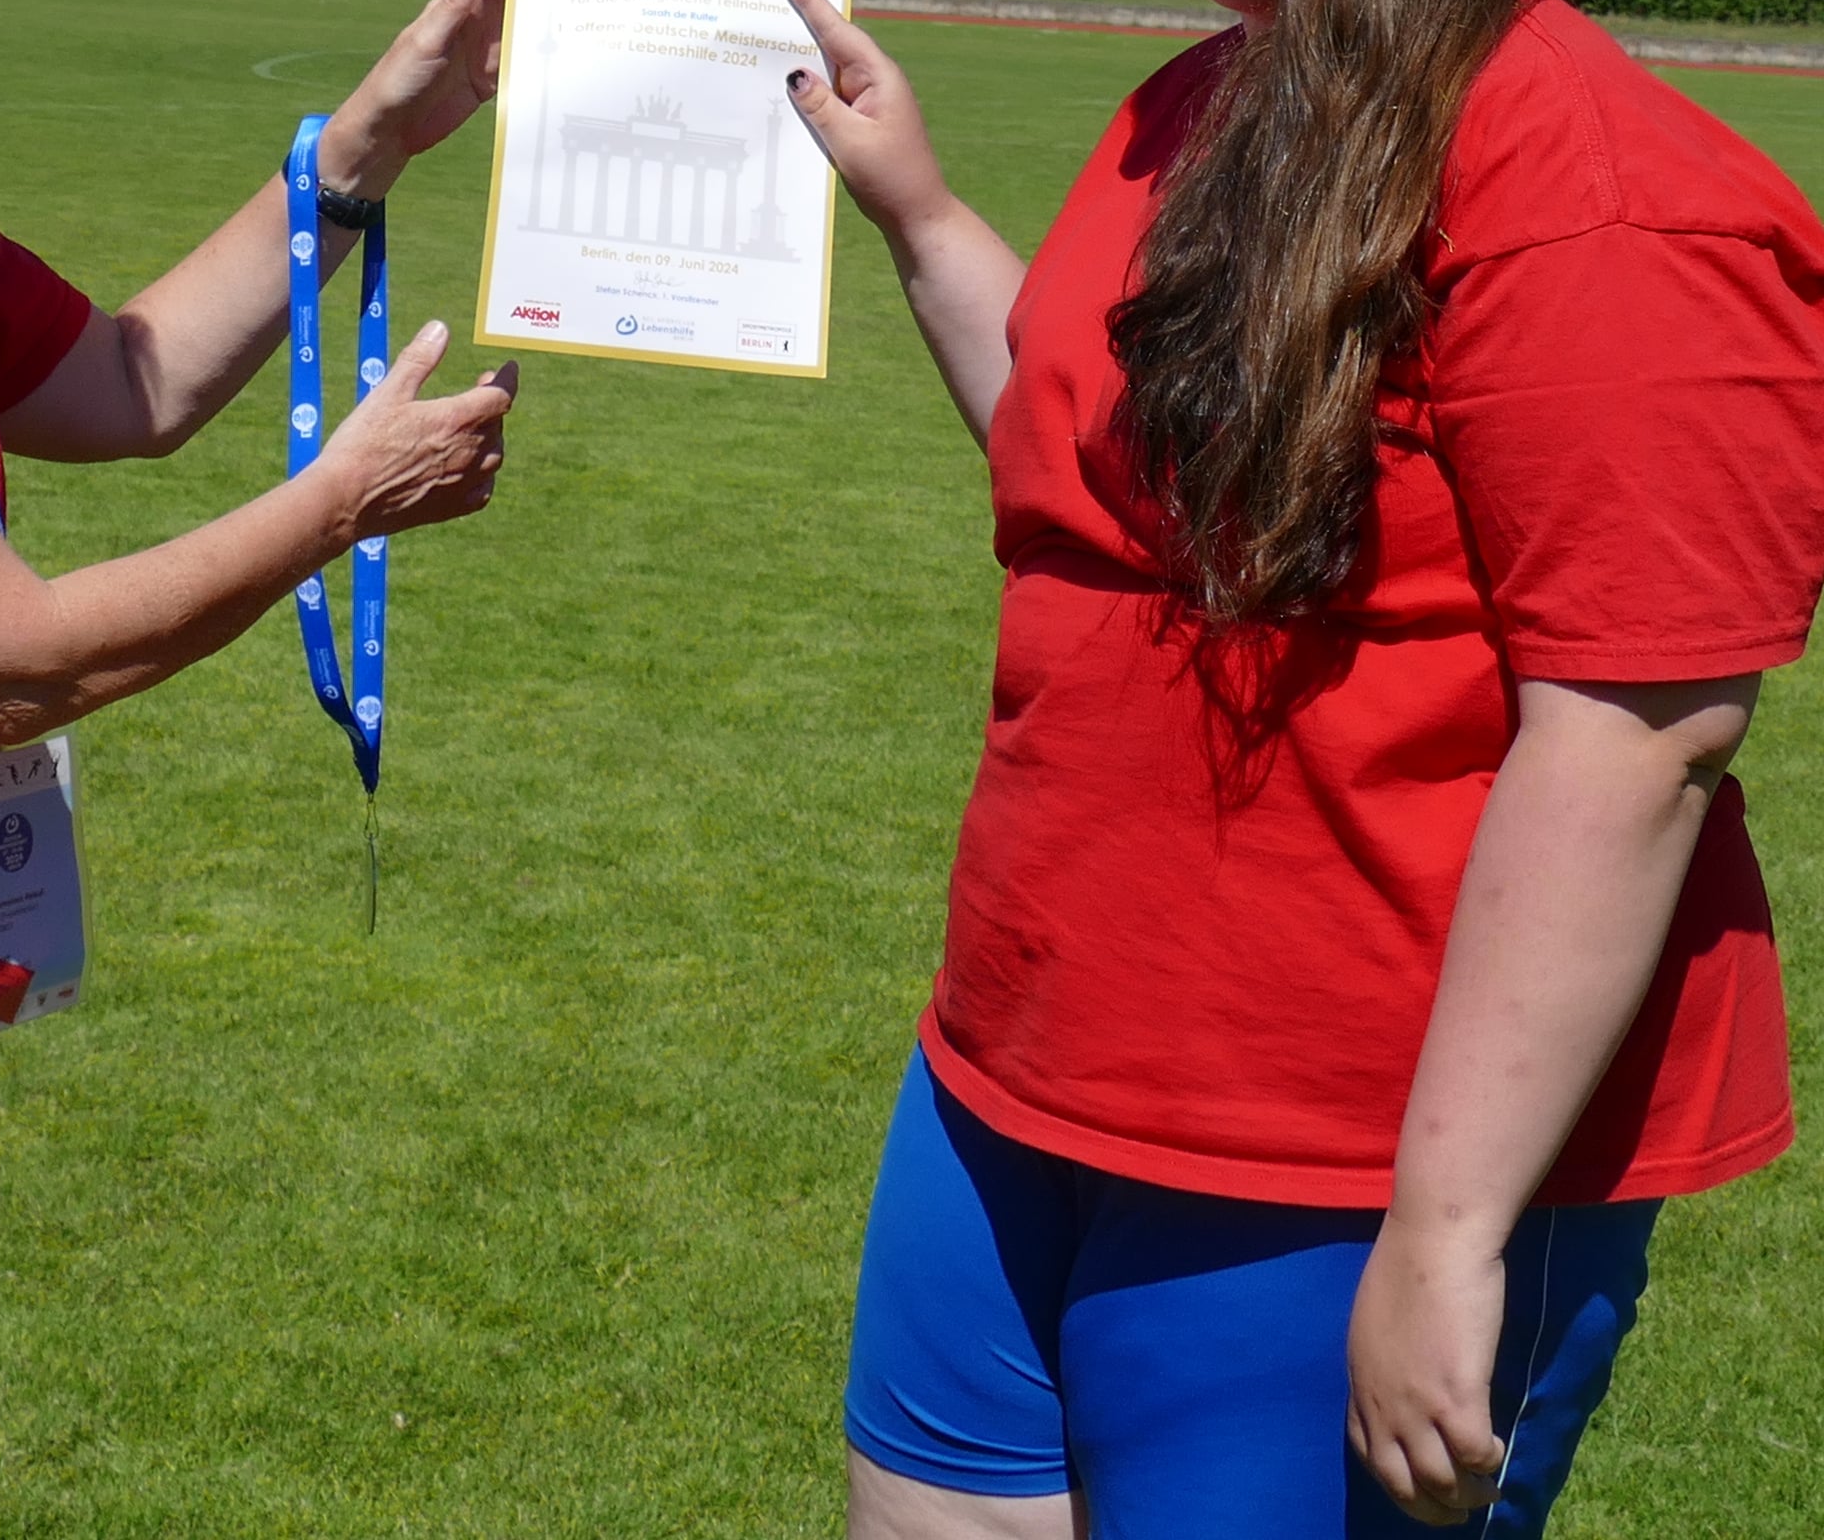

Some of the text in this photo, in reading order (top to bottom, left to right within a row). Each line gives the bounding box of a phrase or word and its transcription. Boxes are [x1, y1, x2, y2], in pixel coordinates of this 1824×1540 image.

[641, 8, 671, 17] Sarah
[673, 11, 687, 19] de
[575, 22, 626, 32] offene
[632, 22, 709, 39] Deutsche
[714, 30, 817, 57] Meisterschaft
[627, 39, 717, 62] Lebenshilfe
[722, 51, 757, 67] 2024
[580, 245, 620, 263] Berlin,
[625, 251, 651, 264] den
[678, 258, 705, 270] Juni
[708, 261, 739, 275] 2024
[595, 285, 620, 294] Stefan
[641, 323, 695, 336] Lebenshilfe
[741, 338, 772, 348] BERLIN
